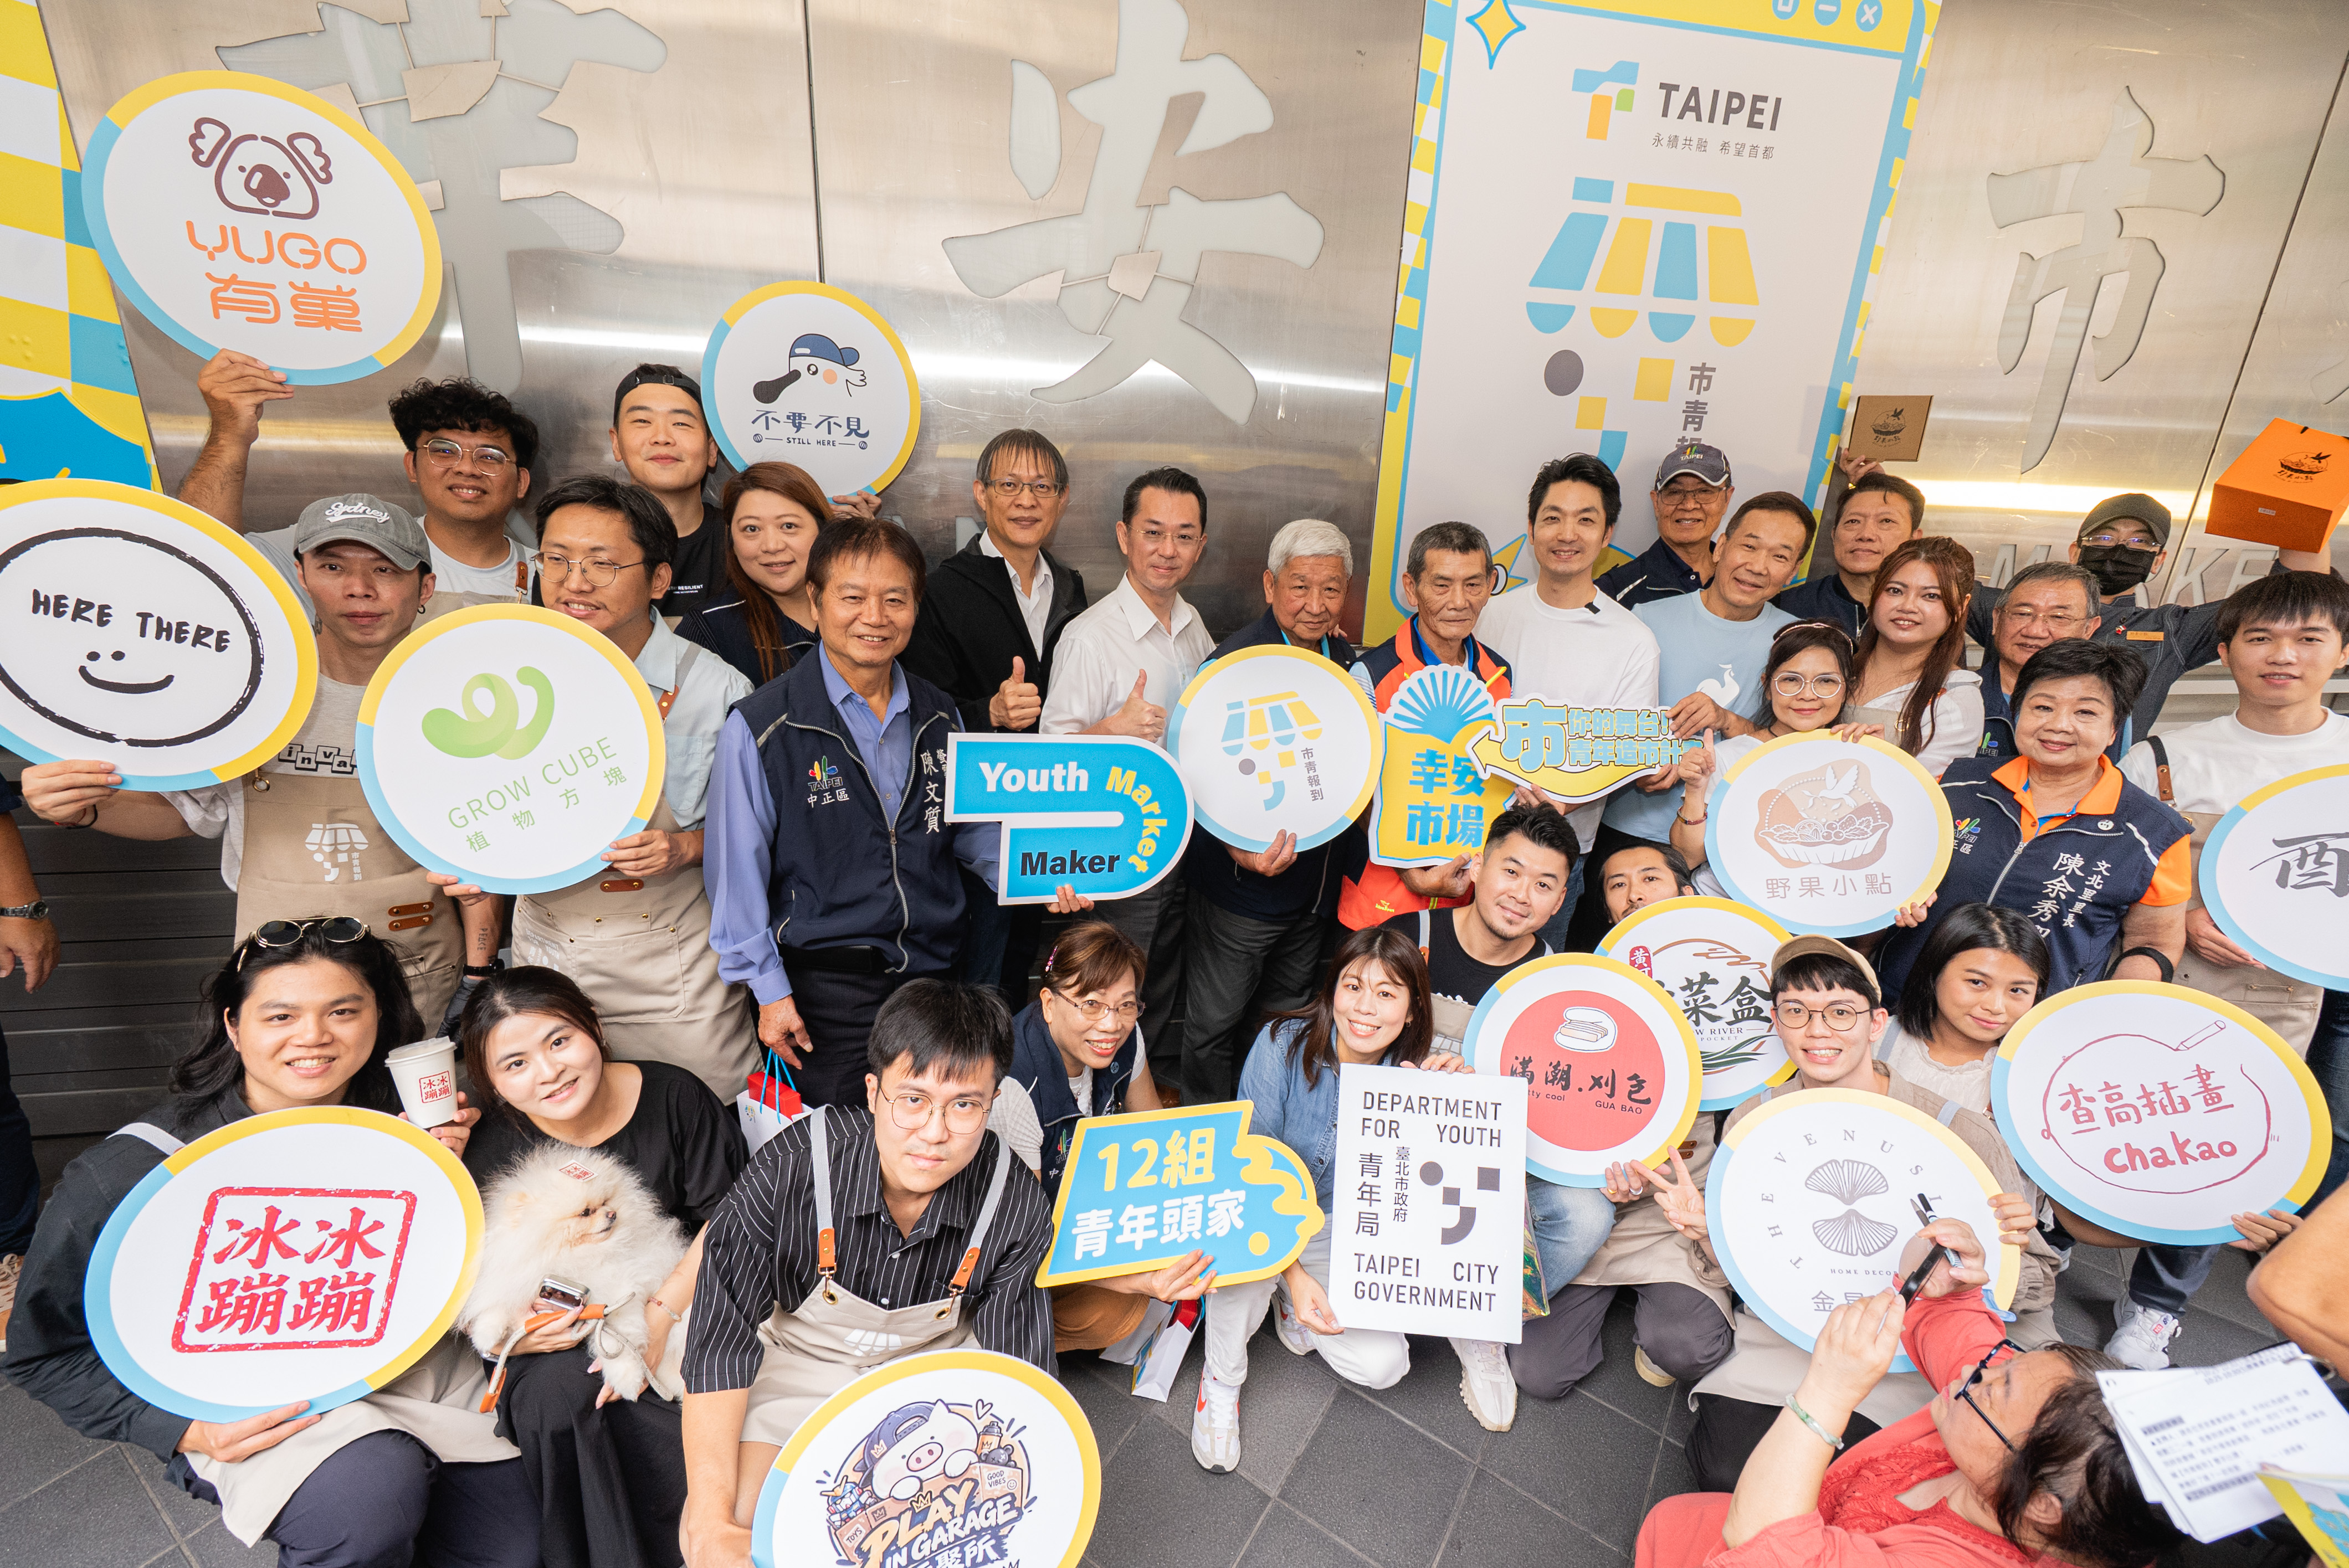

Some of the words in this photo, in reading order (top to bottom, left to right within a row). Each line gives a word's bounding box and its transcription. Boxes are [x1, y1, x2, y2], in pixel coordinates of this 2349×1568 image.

[1659, 82, 1782, 131] TAIPEI
[1652, 132, 1709, 153] 永續共融
[1719, 141, 1775, 161] 希望首都
[186, 220, 367, 275] YUGO
[751, 409, 870, 438] 不要不見
[786, 437, 811, 445] STILL
[325, 502, 390, 523] Sydney
[32, 589, 114, 628] HERE
[136, 611, 231, 653] THERE
[288, 746, 348, 768] inva
[1300, 747, 1325, 802] 市青報到
[1409, 749, 1486, 798] 幸安
[448, 776, 531, 829] GROW
[542, 737, 617, 785] CUBE
[807, 776, 843, 792] TAIPEI
[807, 788, 850, 809] 中正區
[920, 749, 943, 835] 陳文質
[465, 766, 627, 853] 植物方塊
[978, 761, 1089, 793] Youth
[1105, 765, 1168, 873] Market
[1406, 801, 1485, 849] 市場
[1020, 850, 1121, 876] Maker
[1766, 872, 1892, 899] 野果小點
[2062, 860, 2112, 928] 文北里里長
[1655, 971, 1773, 1027] 菜盒
[423, 1075, 448, 1090] 冰冰
[1363, 1091, 1502, 1121] DEPARTMENT
[1546, 1093, 1565, 1101] cool
[1595, 1100, 1616, 1111] GUA
[1620, 1104, 1643, 1114] BAO
[1361, 1118, 1400, 1139] FOR
[1436, 1124, 1501, 1148] YOUTH
[1773, 1129, 1923, 1175] VENUS
[1097, 1127, 1215, 1191] 12組
[1355, 1152, 1383, 1237] 青年局
[1392, 1146, 1411, 1222] 臺北市政府
[213, 1205, 387, 1269] 冰冰
[1071, 1189, 1247, 1261] 青年頭家
[1354, 1253, 1420, 1278] TAIPEI
[1453, 1262, 1499, 1285] CITY
[194, 1271, 377, 1336] 蹦蹦
[1354, 1281, 1496, 1312] GOVERNMENT
[987, 1470, 1005, 1481] GOOD
[988, 1477, 1006, 1488] VIBES
[845, 1527, 863, 1545] TOYS
[860, 1479, 976, 1568] PLAY
[911, 1495, 1019, 1560] GARAGE
